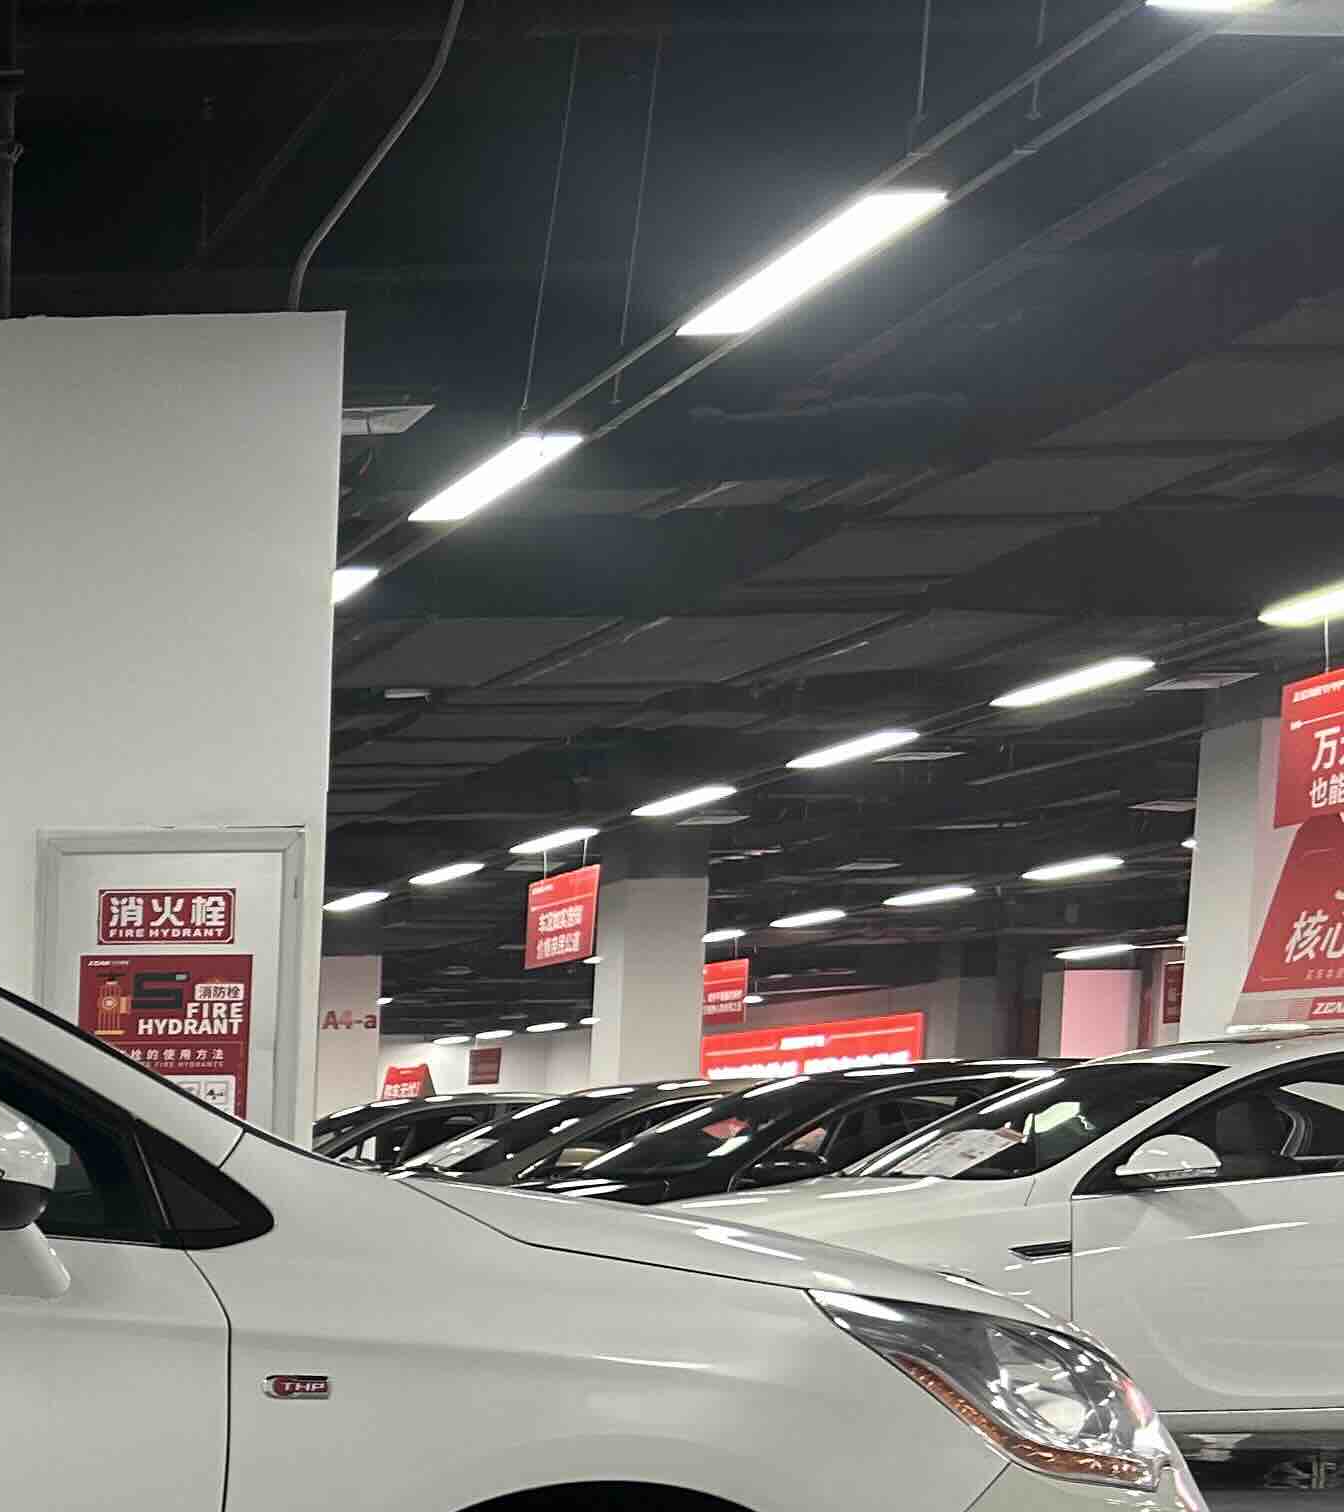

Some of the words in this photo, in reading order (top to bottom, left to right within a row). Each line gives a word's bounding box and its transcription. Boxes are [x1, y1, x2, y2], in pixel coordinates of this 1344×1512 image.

[1312, 725, 1344, 772] 万
[108, 895, 226, 927] 消火栓
[108, 928, 145, 938] FIRE
[148, 927, 225, 938] HYDRANT
[198, 985, 241, 1000] 消防栓
[186, 1002, 244, 1019] FIRE
[137, 1018, 243, 1036] HYDRANT
[120, 1047, 225, 1061] 栓的使用方法
[280, 1382, 326, 1392] THP
